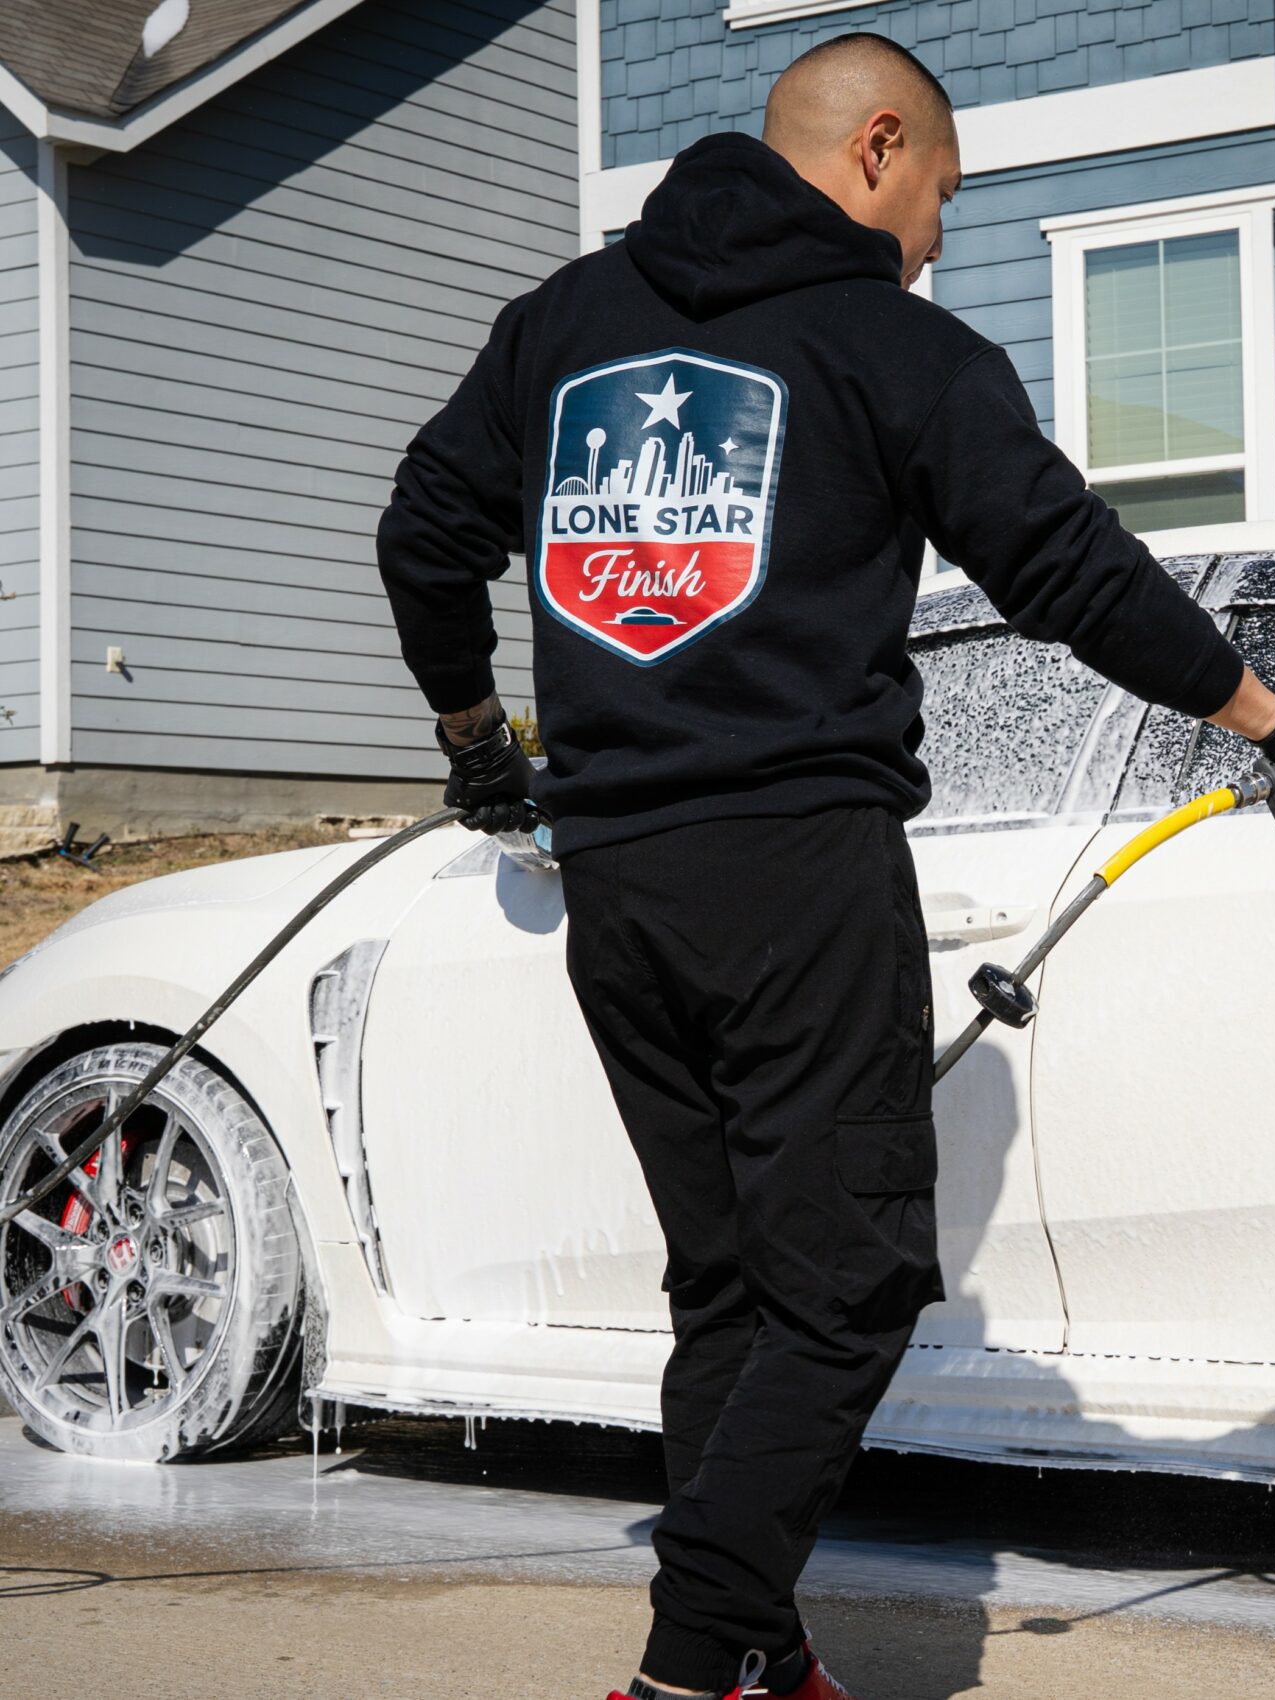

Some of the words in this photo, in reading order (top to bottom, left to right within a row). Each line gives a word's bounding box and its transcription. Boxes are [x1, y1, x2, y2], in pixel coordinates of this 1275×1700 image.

[552, 504, 640, 534] LONE
[653, 504, 754, 535] STAR
[579, 549, 706, 601] Finish
[97, 1057, 149, 1073] MICHE
